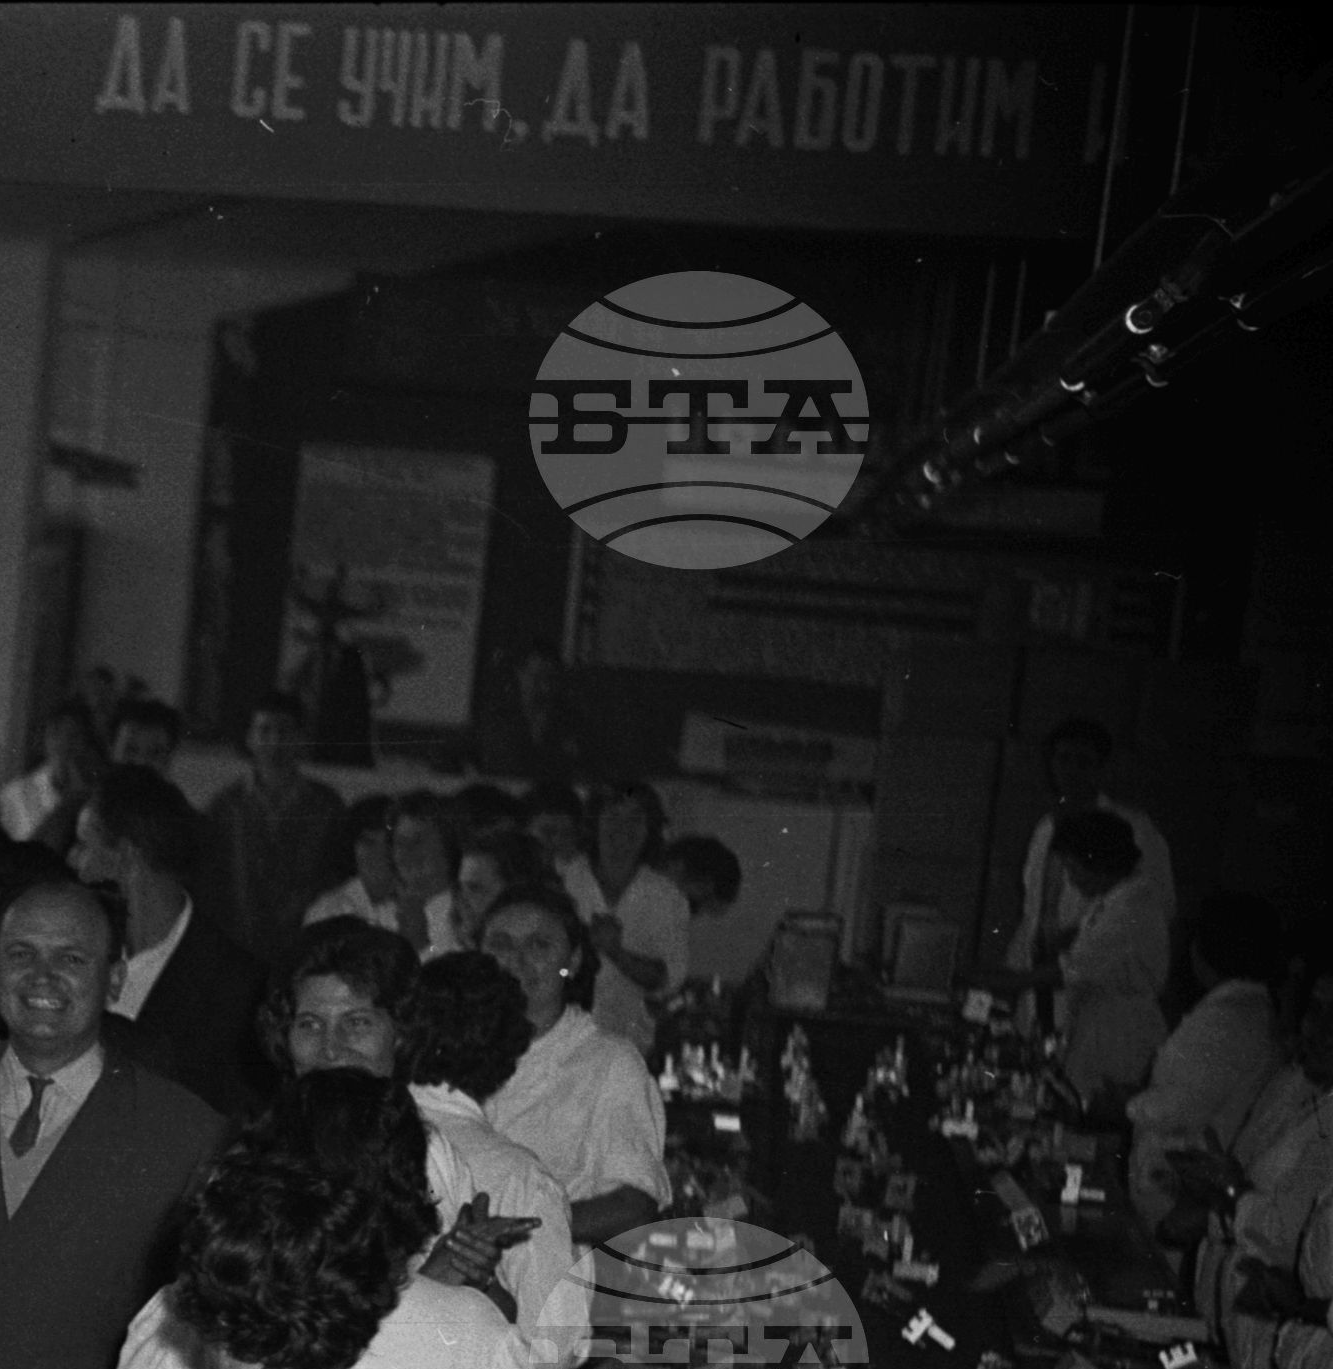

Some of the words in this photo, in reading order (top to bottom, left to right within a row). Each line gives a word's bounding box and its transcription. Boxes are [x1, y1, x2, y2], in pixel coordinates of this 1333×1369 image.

[92, 14, 192, 117] ДА
[229, 20, 313, 122] СЕ
[540, 37, 651, 149] ДА
[696, 44, 1037, 161] РАБОТИМ
